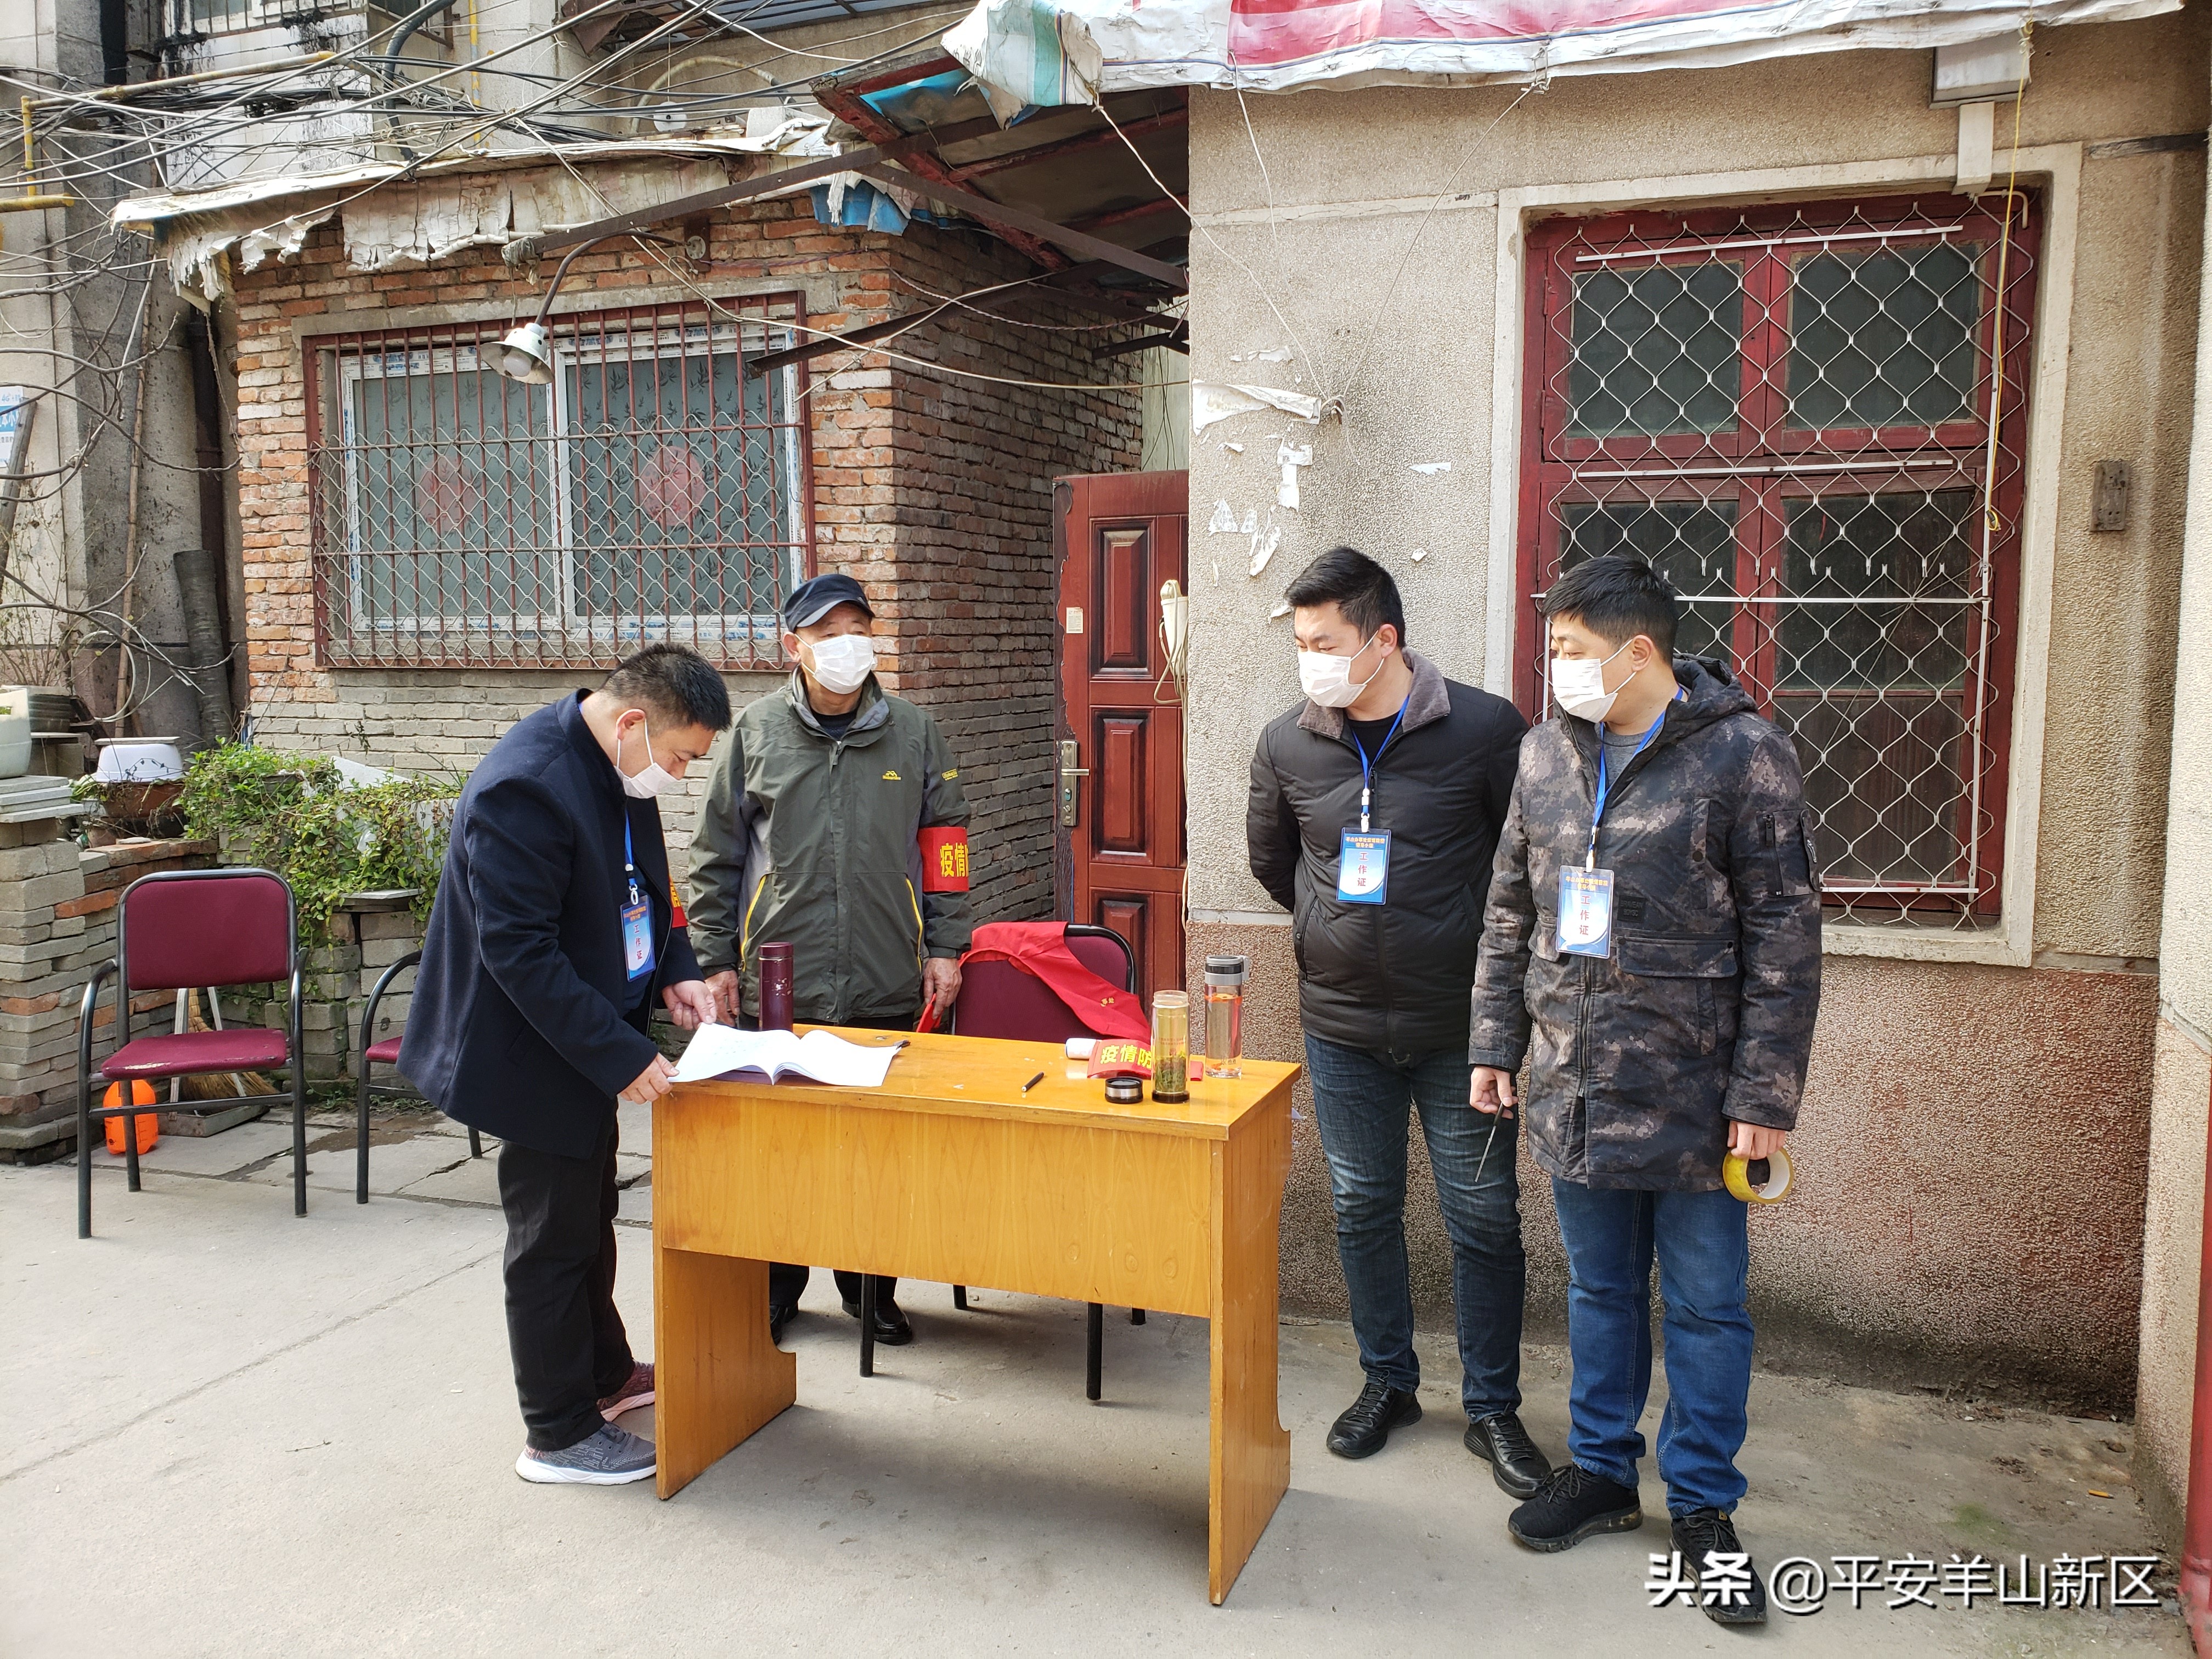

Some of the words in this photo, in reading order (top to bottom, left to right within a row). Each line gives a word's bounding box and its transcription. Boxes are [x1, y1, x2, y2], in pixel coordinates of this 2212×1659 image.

[940, 842, 968, 877] 疫情
[1357, 853, 1368, 887] 工作证
[1579, 896, 1590, 935] 工作证
[634, 925, 642, 960] 工作证
